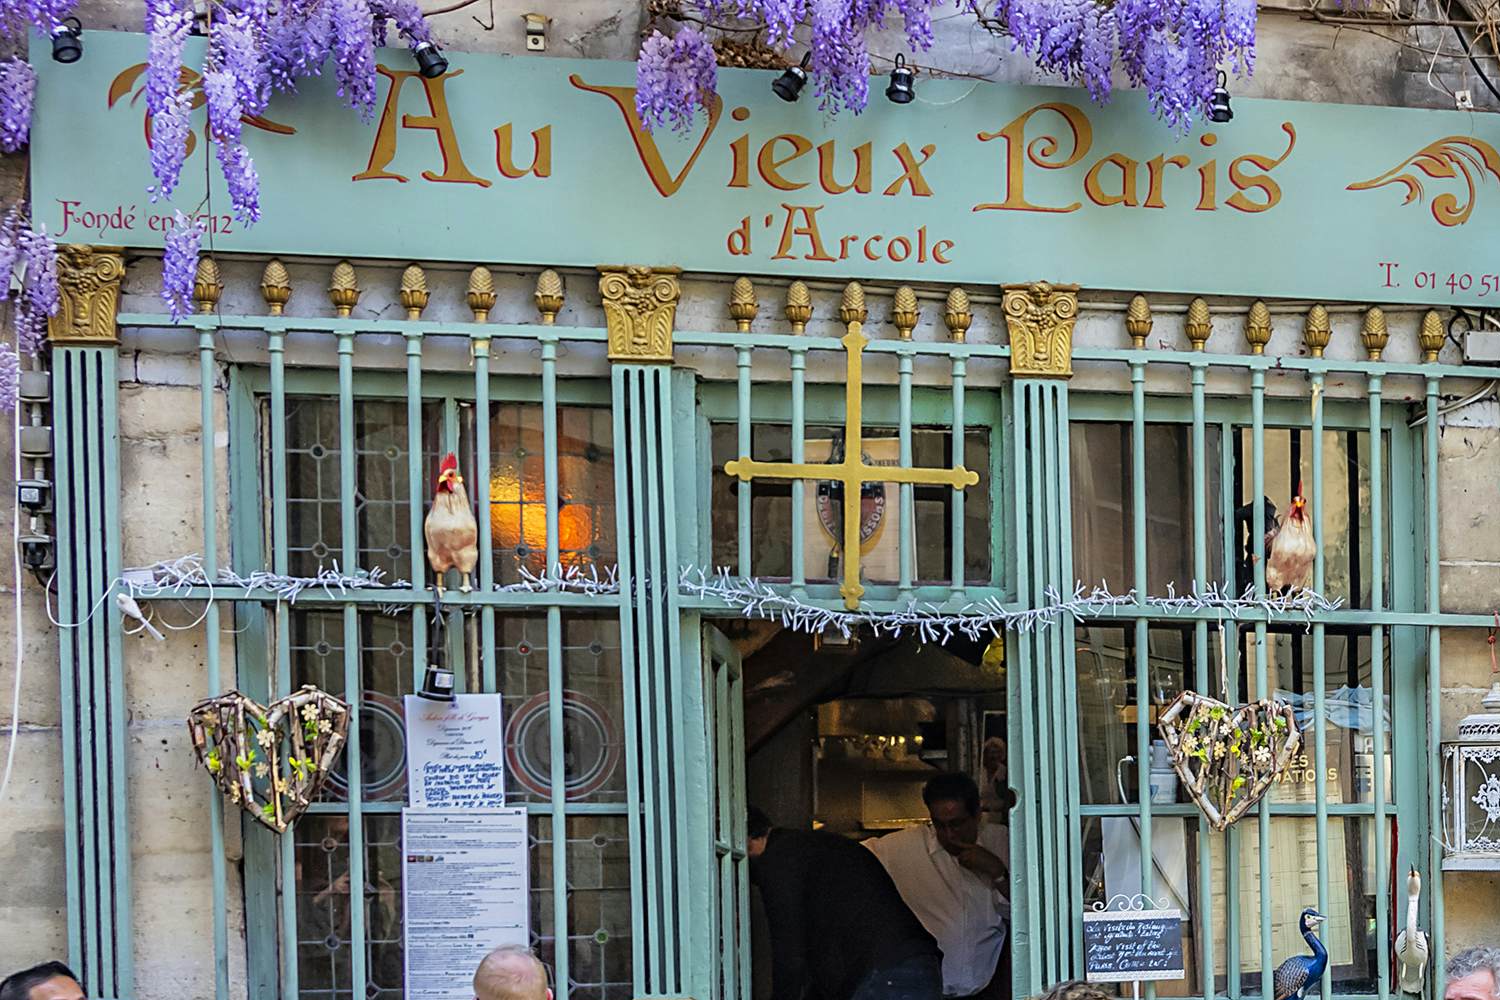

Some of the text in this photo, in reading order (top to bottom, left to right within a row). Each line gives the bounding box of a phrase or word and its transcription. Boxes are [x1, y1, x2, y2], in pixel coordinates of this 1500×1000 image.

[352, 63, 1297, 213] Au Vieux Paris
[54, 197, 136, 239] Fondé
[148, 214, 175, 233] en
[726, 202, 956, 266] d'Arcole
[1378, 262, 1401, 288] T.
[1414, 271, 1436, 290] 01
[1445, 273, 1473, 295] 40
[1478, 274, 1499, 297] 51
